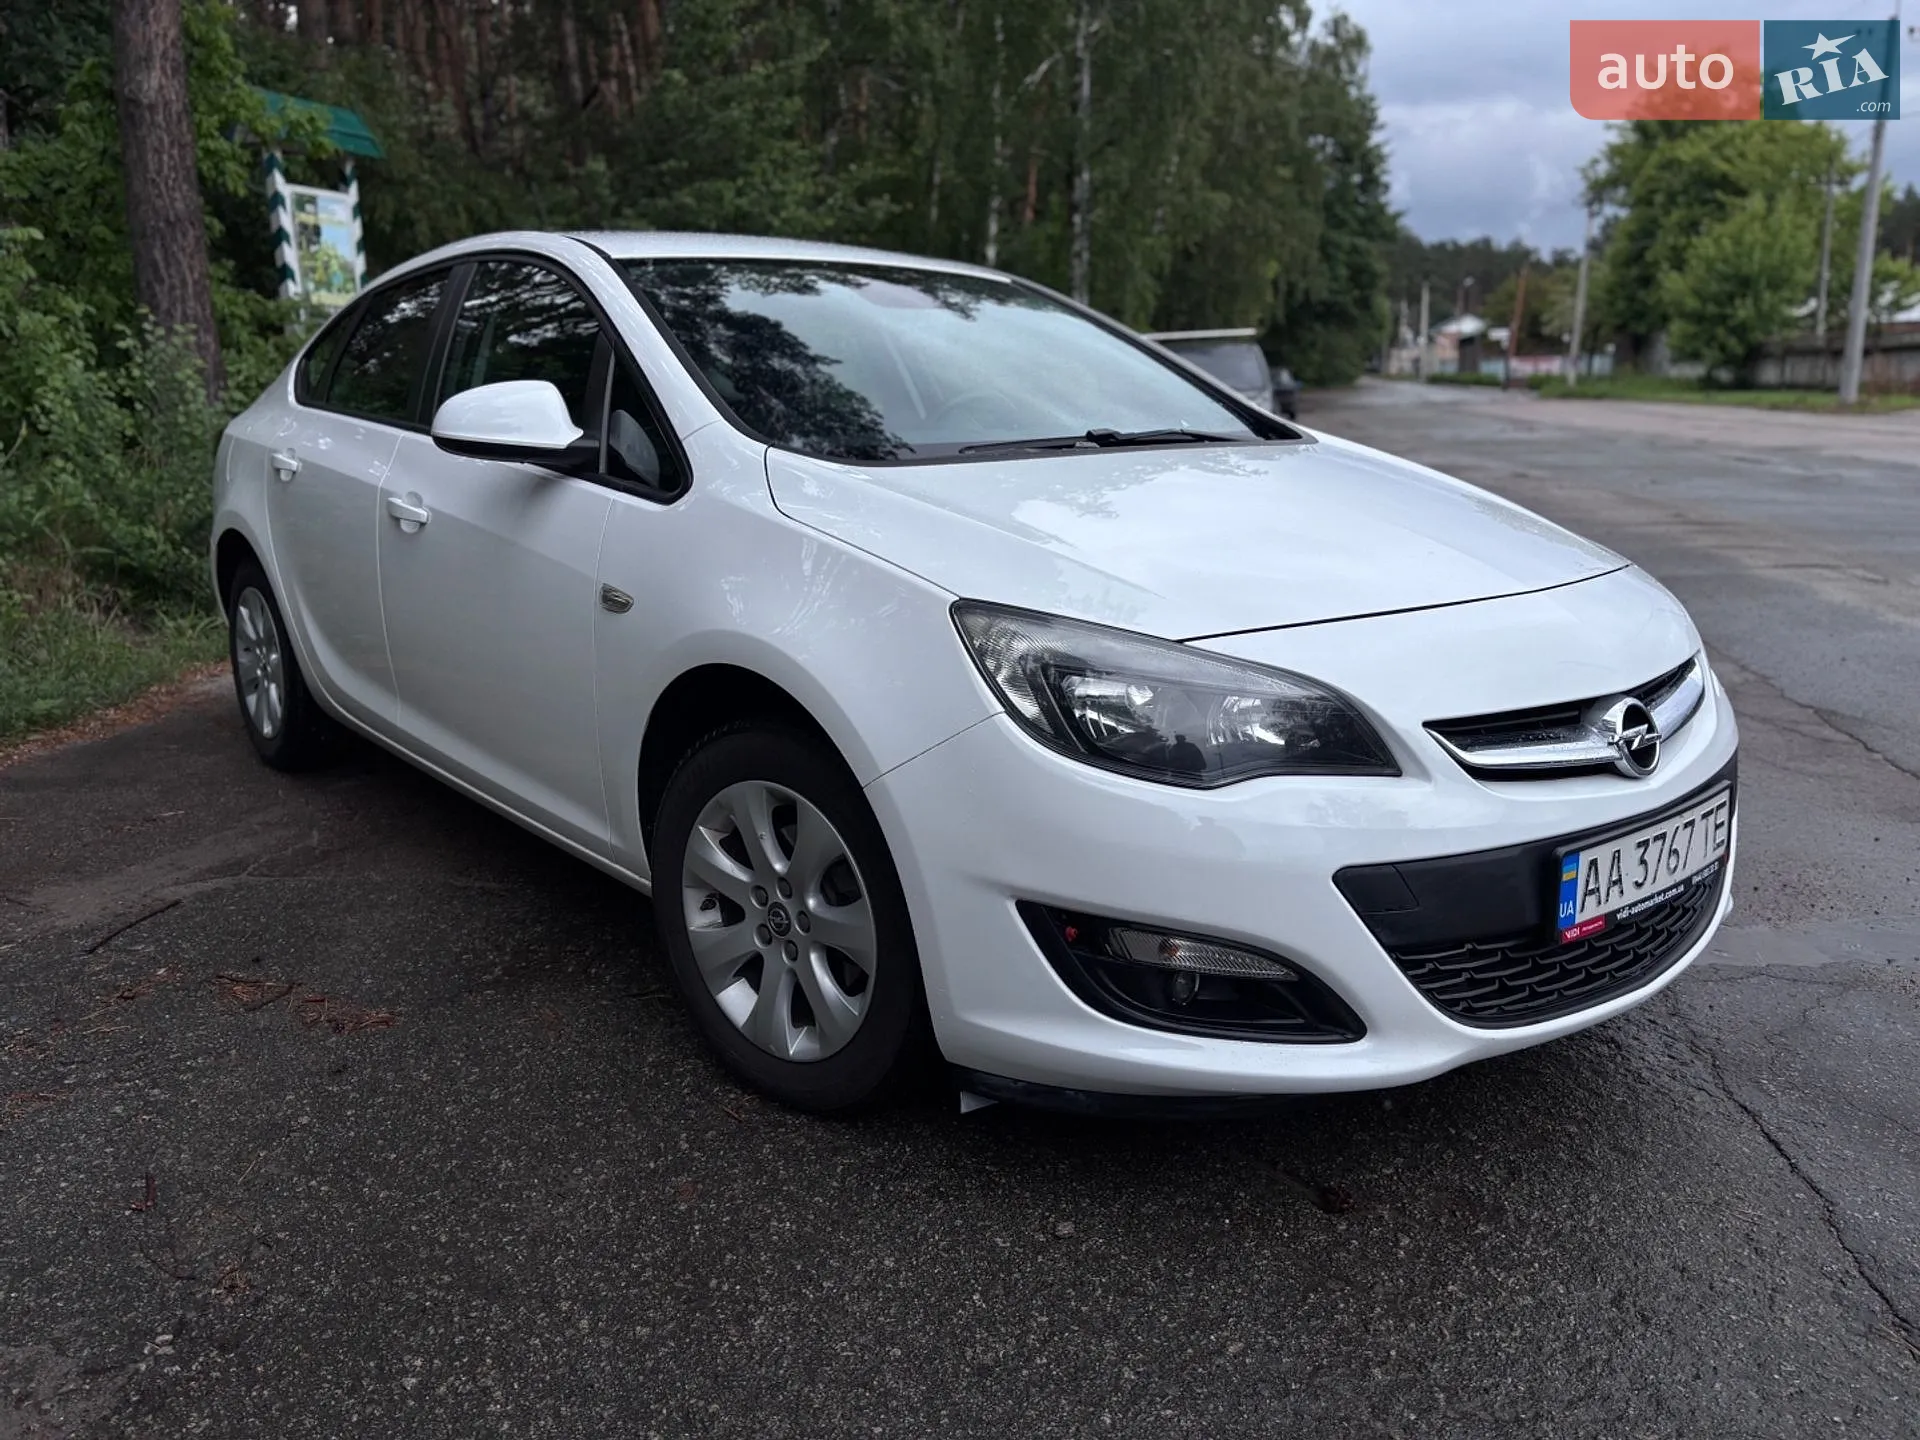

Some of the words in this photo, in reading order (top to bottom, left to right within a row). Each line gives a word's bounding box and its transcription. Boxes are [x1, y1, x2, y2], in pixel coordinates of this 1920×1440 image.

[1579, 849, 1624, 913] AA
[1633, 818, 1695, 890] 3767
[1700, 800, 1728, 858] TE
[1559, 901, 1574, 918] UA
